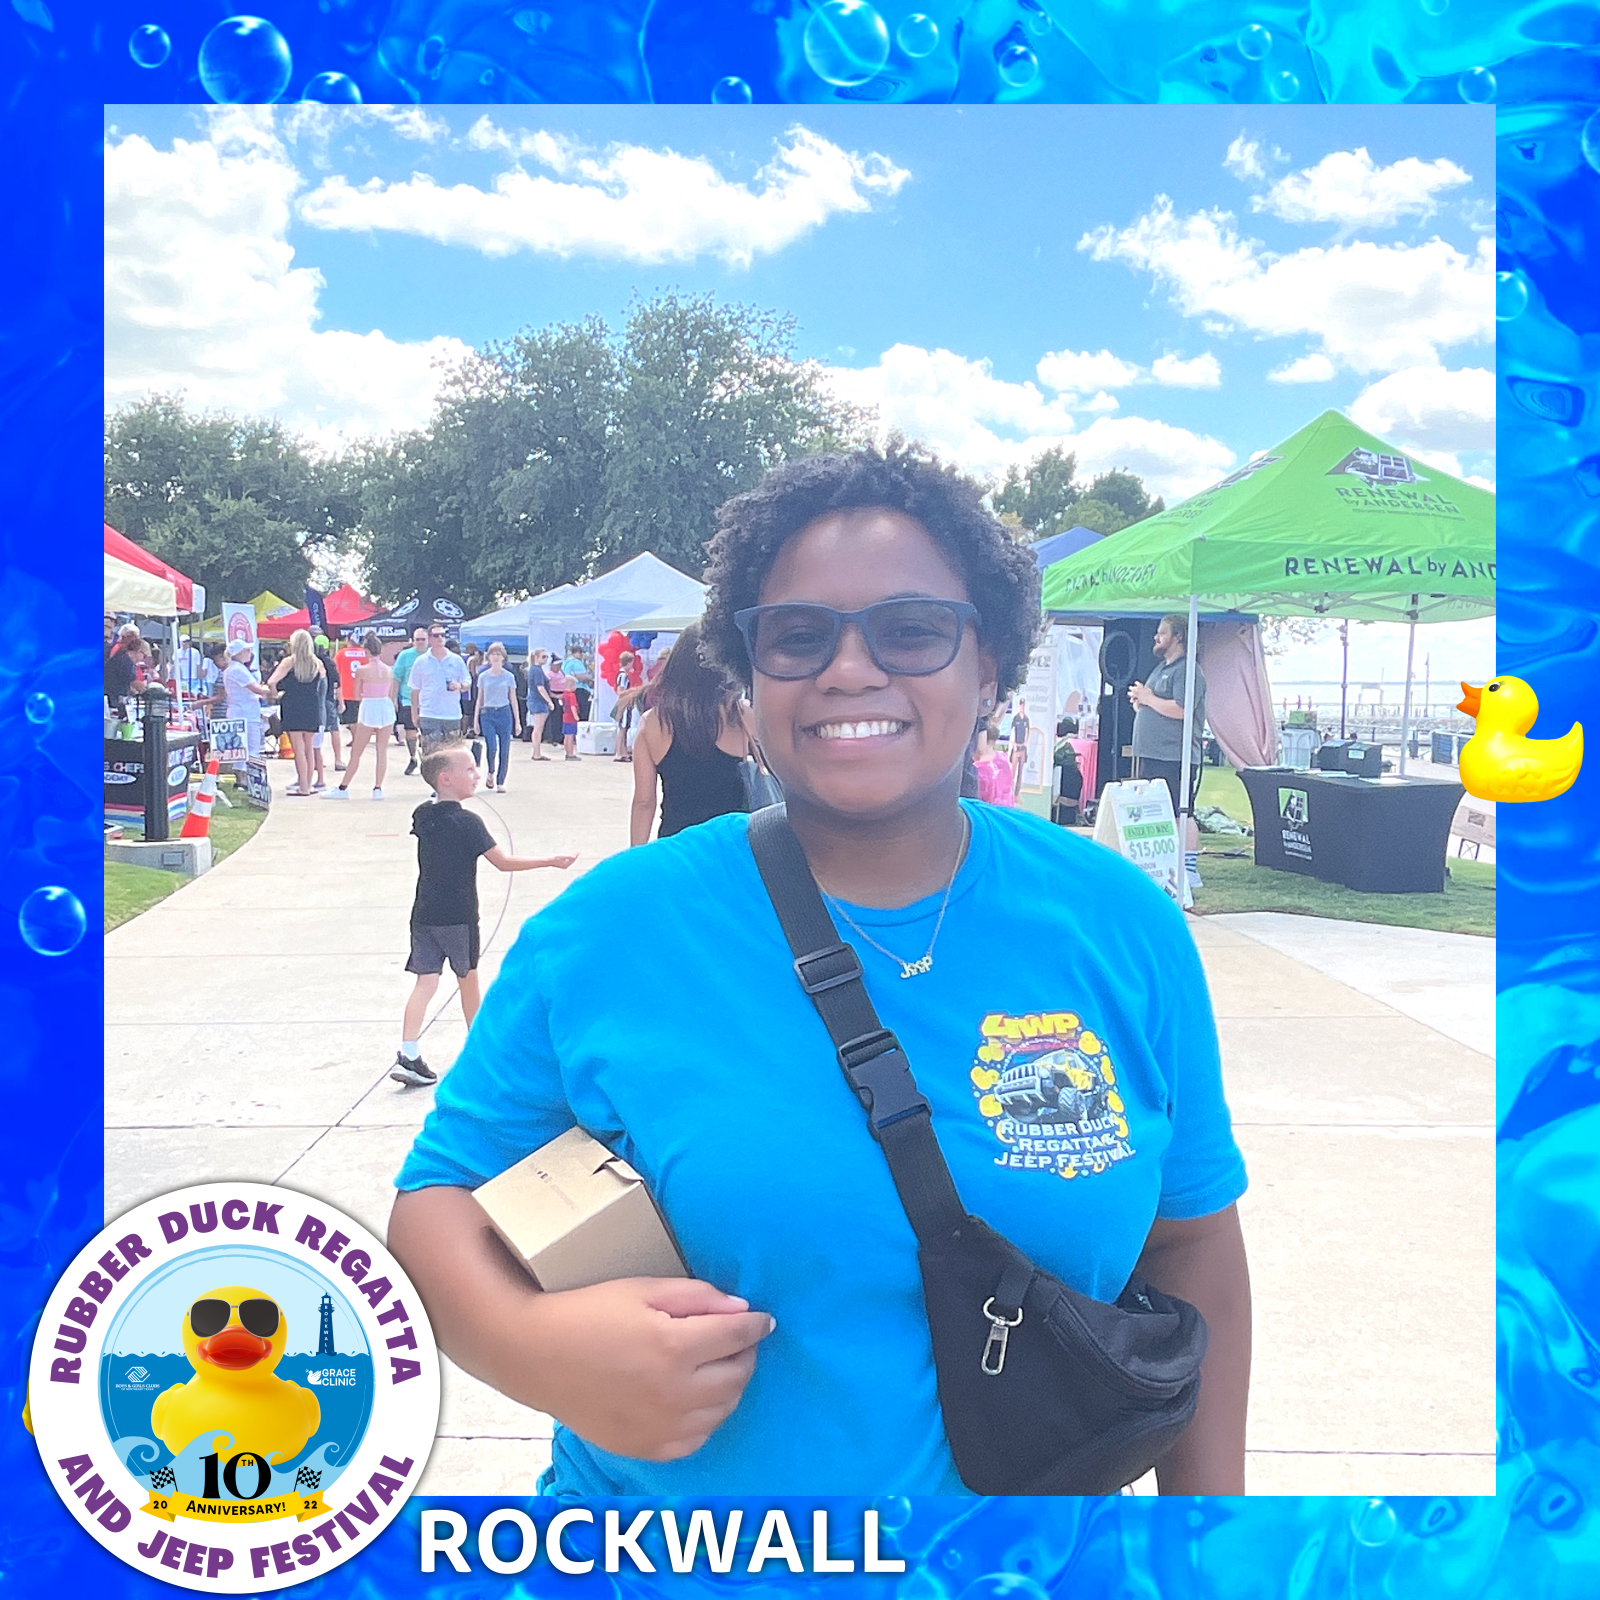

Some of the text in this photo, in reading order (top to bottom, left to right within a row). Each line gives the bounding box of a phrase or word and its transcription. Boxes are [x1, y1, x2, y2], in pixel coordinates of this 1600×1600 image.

[1335, 487, 1452, 504] RENEWAL
[1343, 498, 1460, 514] by ANDERSEN
[1285, 555, 1423, 576] RENEWAL
[1428, 556, 1447, 577] by
[212, 720, 244, 733] VOTE
[1129, 838, 1175, 860] $15,000
[1001, 1113, 1119, 1136] RUBBER DUCK
[1019, 1135, 1102, 1151] REGATTA
[994, 1144, 1136, 1168] JEEP FESTIVAL
